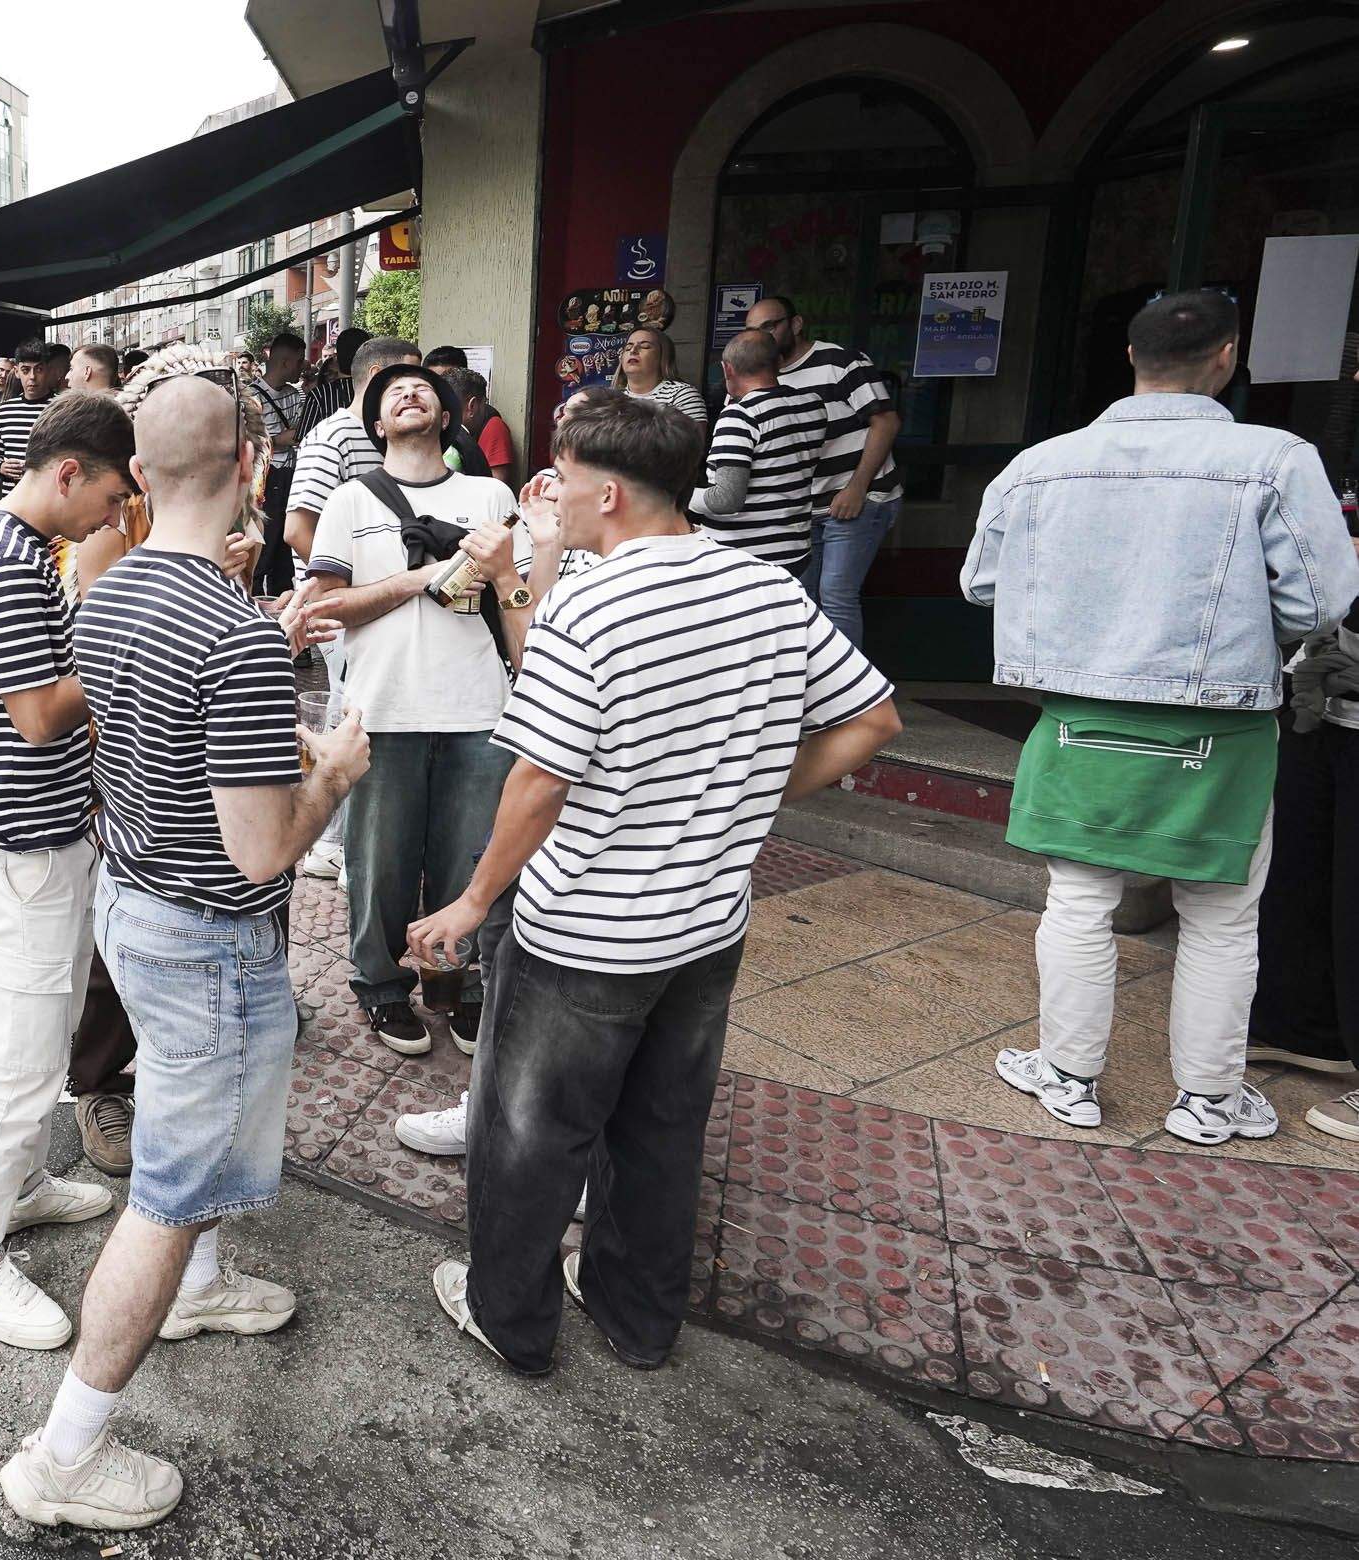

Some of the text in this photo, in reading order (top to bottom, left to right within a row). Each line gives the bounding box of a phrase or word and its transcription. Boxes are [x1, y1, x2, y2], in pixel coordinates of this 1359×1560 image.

[930, 280, 999, 290] ESTADIO M.
[930, 290, 997, 299] SAN PEDRO
[1182, 759, 1203, 771] PG
